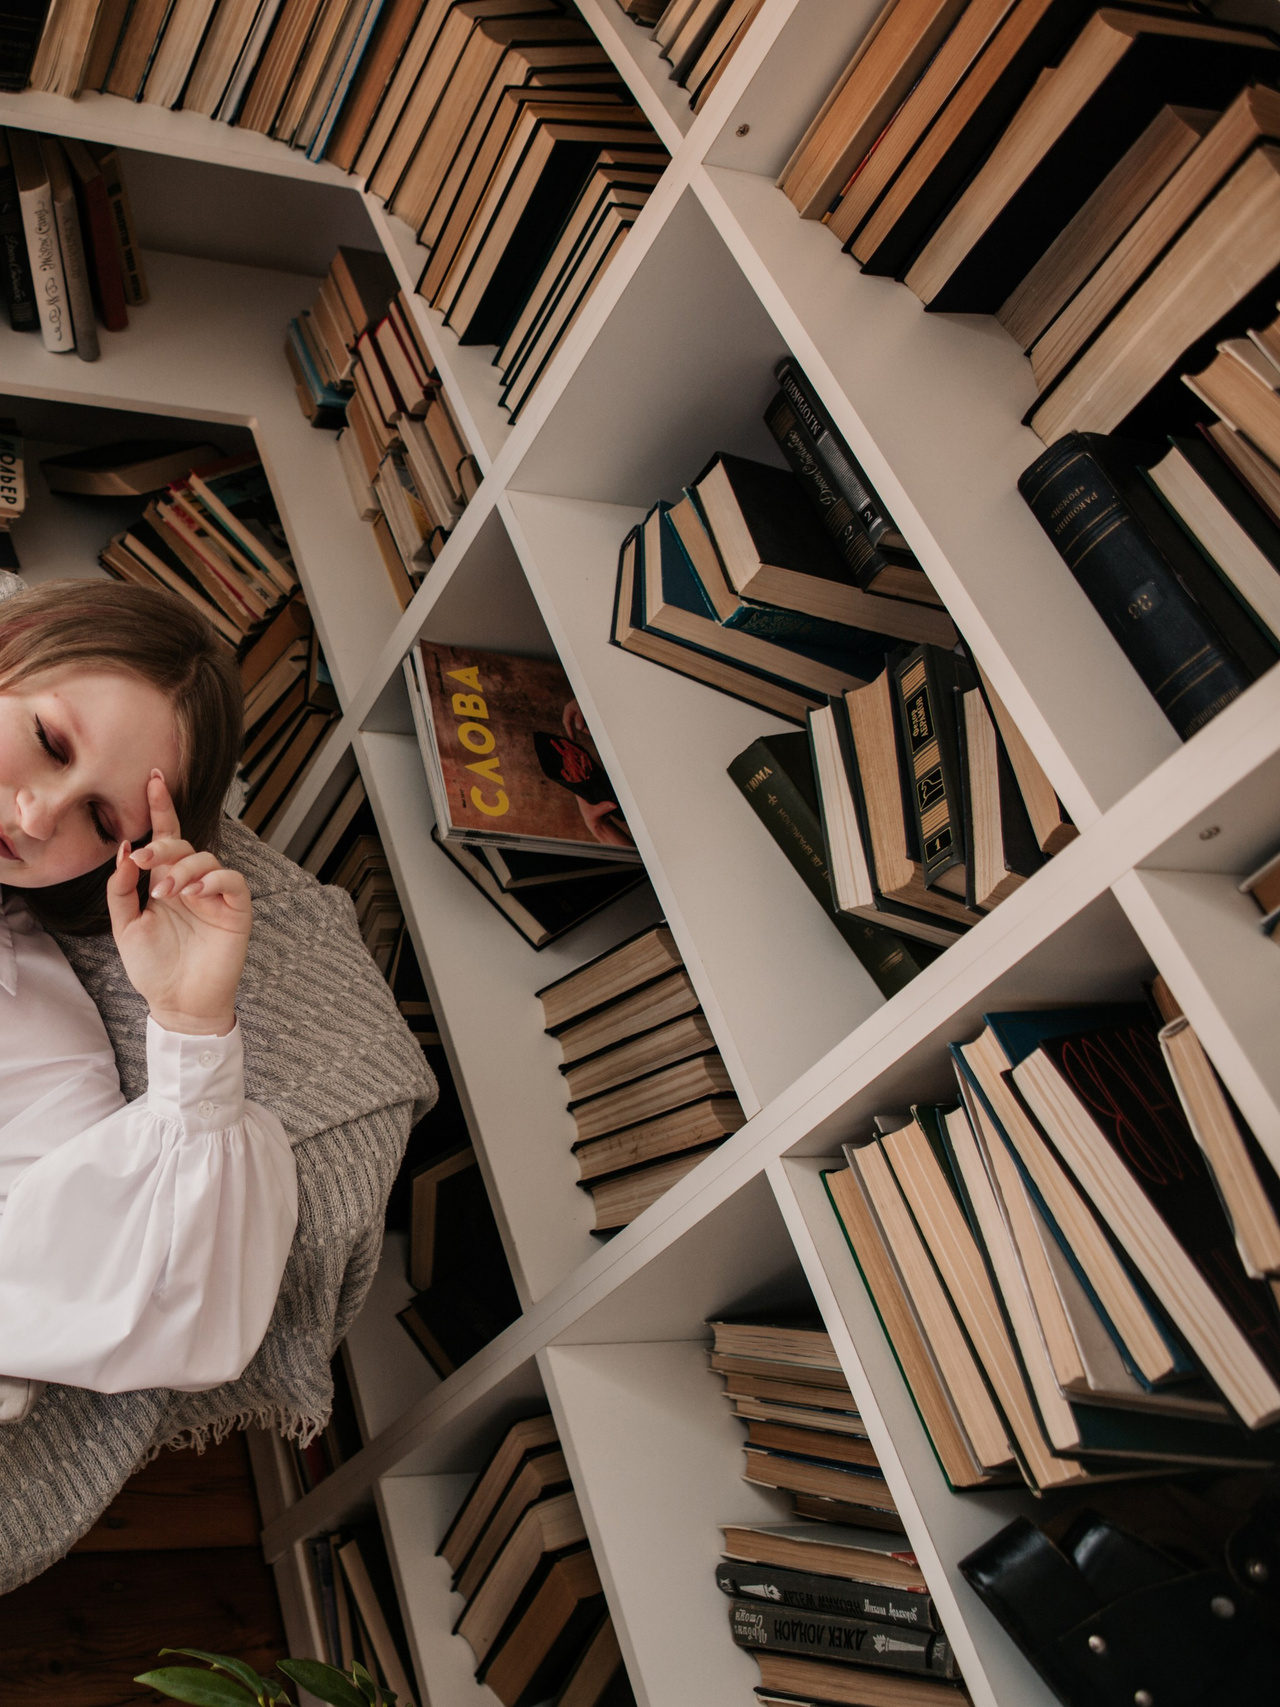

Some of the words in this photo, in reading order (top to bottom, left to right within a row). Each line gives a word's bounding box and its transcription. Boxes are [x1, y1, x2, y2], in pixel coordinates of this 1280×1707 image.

[446, 665, 509, 816] СЛОВА
[774, 1621, 827, 1646] ЛОНДОН
[829, 1626, 867, 1650] ДЖЕК
